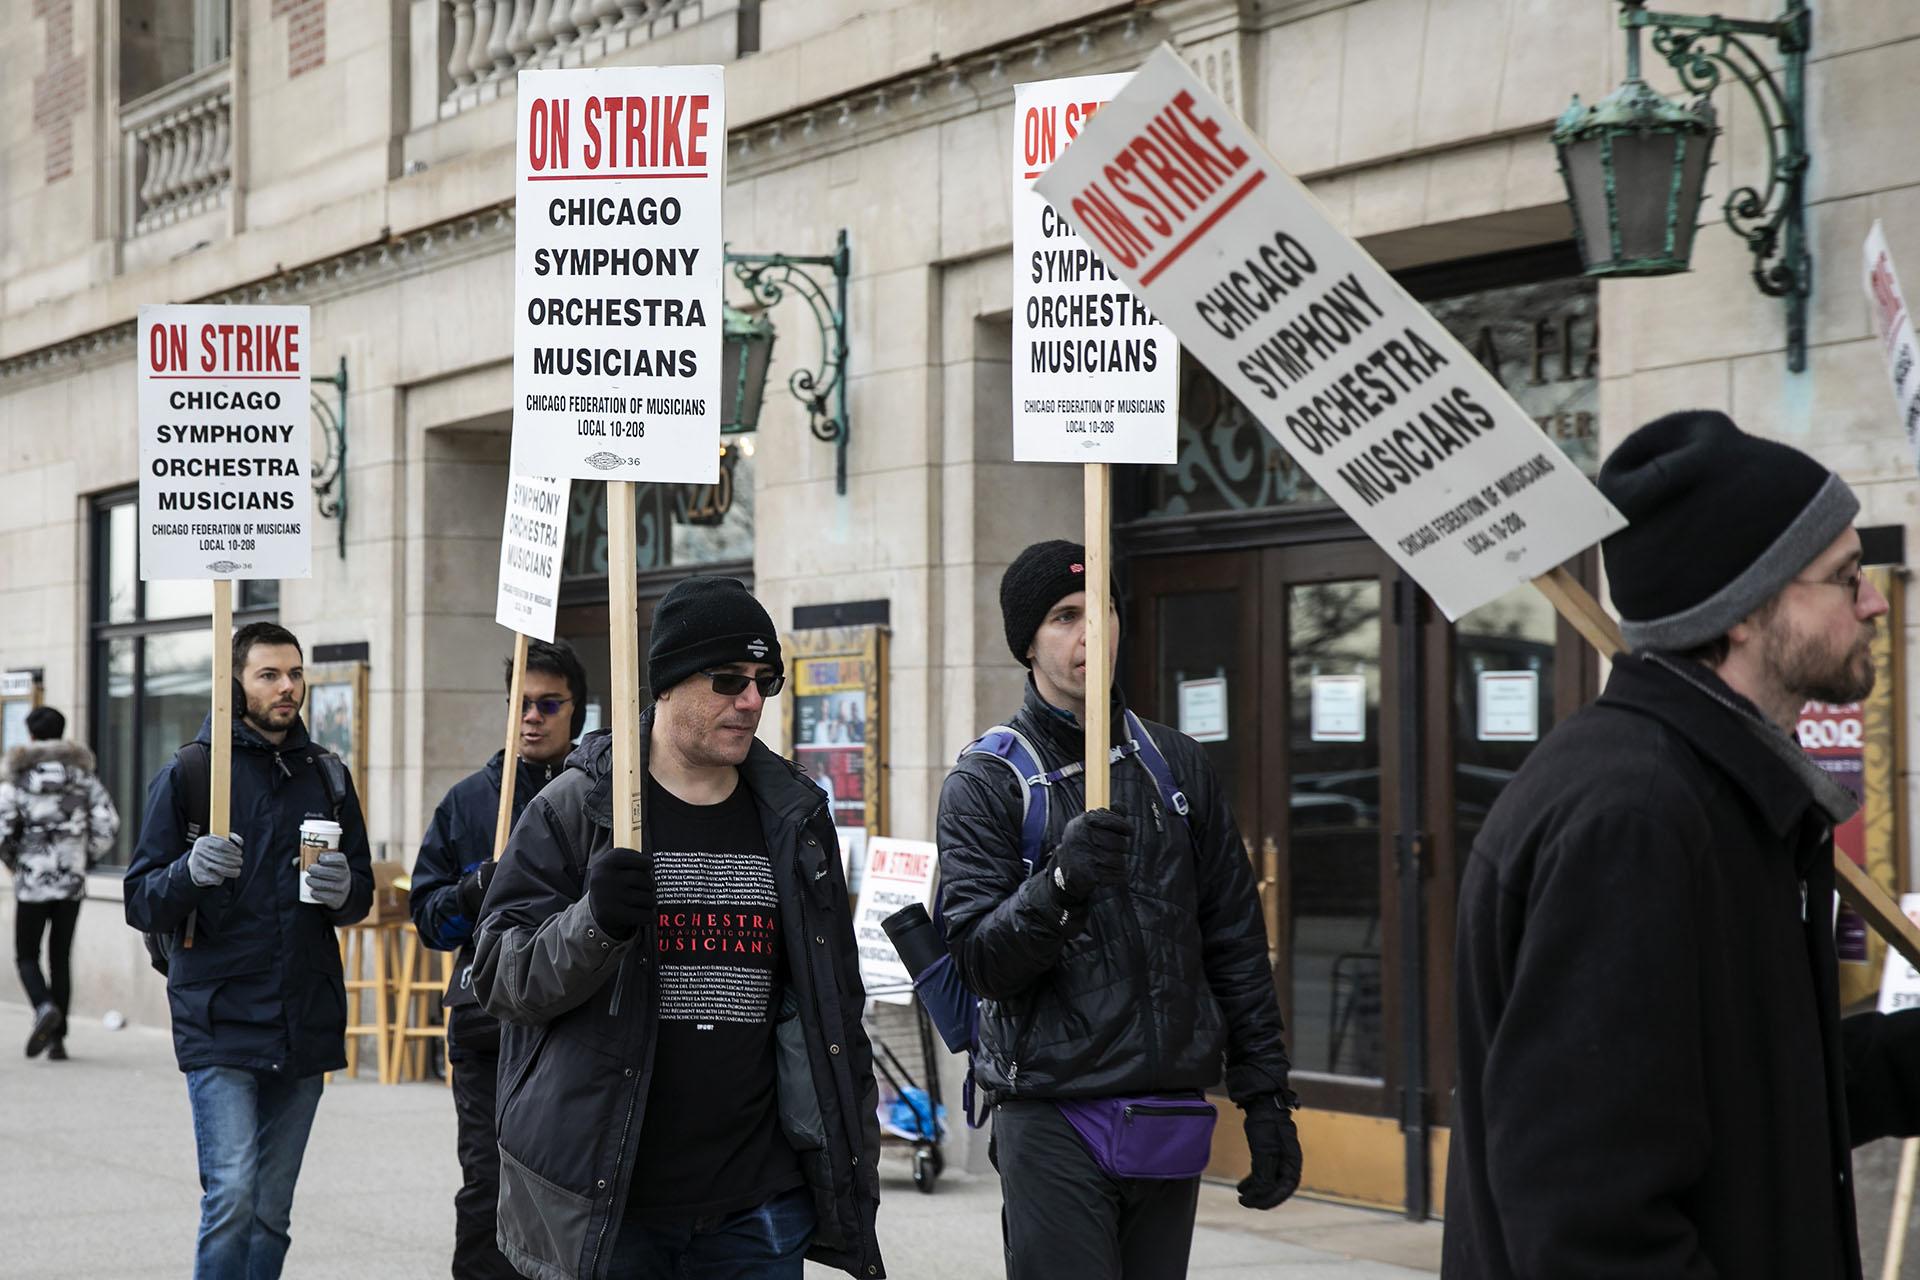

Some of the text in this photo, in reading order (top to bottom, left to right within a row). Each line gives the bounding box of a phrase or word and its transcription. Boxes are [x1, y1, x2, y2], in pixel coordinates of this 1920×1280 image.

[529, 95, 709, 171] ON STRIKE
[1024, 106, 1055, 166] ON
[1104, 89, 1249, 237] STRIKE
[548, 197, 681, 226] CHICAGO
[1072, 181, 1154, 269] ON
[534, 248, 700, 276] SYMPHONY
[1032, 249, 1119, 284] SYMPH
[1195, 231, 1318, 341] CHICAGO
[528, 298, 706, 327] ORCHESTRA
[150, 323, 300, 372] ON STRIKE
[1238, 273, 1385, 399] SYMPHONY
[533, 347, 697, 377] MUSICIANS
[1031, 339, 1157, 374] MUSICIANS
[169, 391, 281, 410] CHICAGO
[526, 394, 706, 416] CHICAGO FEDERATION OF MUSICIANS
[1285, 327, 1450, 456] ORCHESTRA
[1024, 399, 1165, 414] CHICAGO FEDERATION OF MUSICIANS
[156, 425, 294, 444] SYMPHONY
[578, 419, 645, 438] LOCAL 10-208
[1065, 420, 1115, 434] LOCAL 10-208
[1337, 385, 1496, 506] MUSICIANS
[151, 458, 300, 477] ORCHESTRA
[627, 457, 641, 466] 36
[158, 491, 295, 511] MUSICIANS
[514, 483, 560, 516] SYMPHONY
[1398, 453, 1555, 556] CHICAGO FEDERATION OF MUSICIANS
[152, 523, 301, 535] CHICAGO FEDERATION OF MUSICIANS
[509, 513, 558, 548] ORCHESTRA
[1464, 531, 1496, 555] LOCAL
[199, 539, 255, 551] LOCAL 10-208
[507, 543, 553, 579] MUSICIANS
[872, 849, 930, 878] ON STRIKE
[659, 913, 774, 930] RCHESTRA
[658, 938, 773, 955] USICIANS
